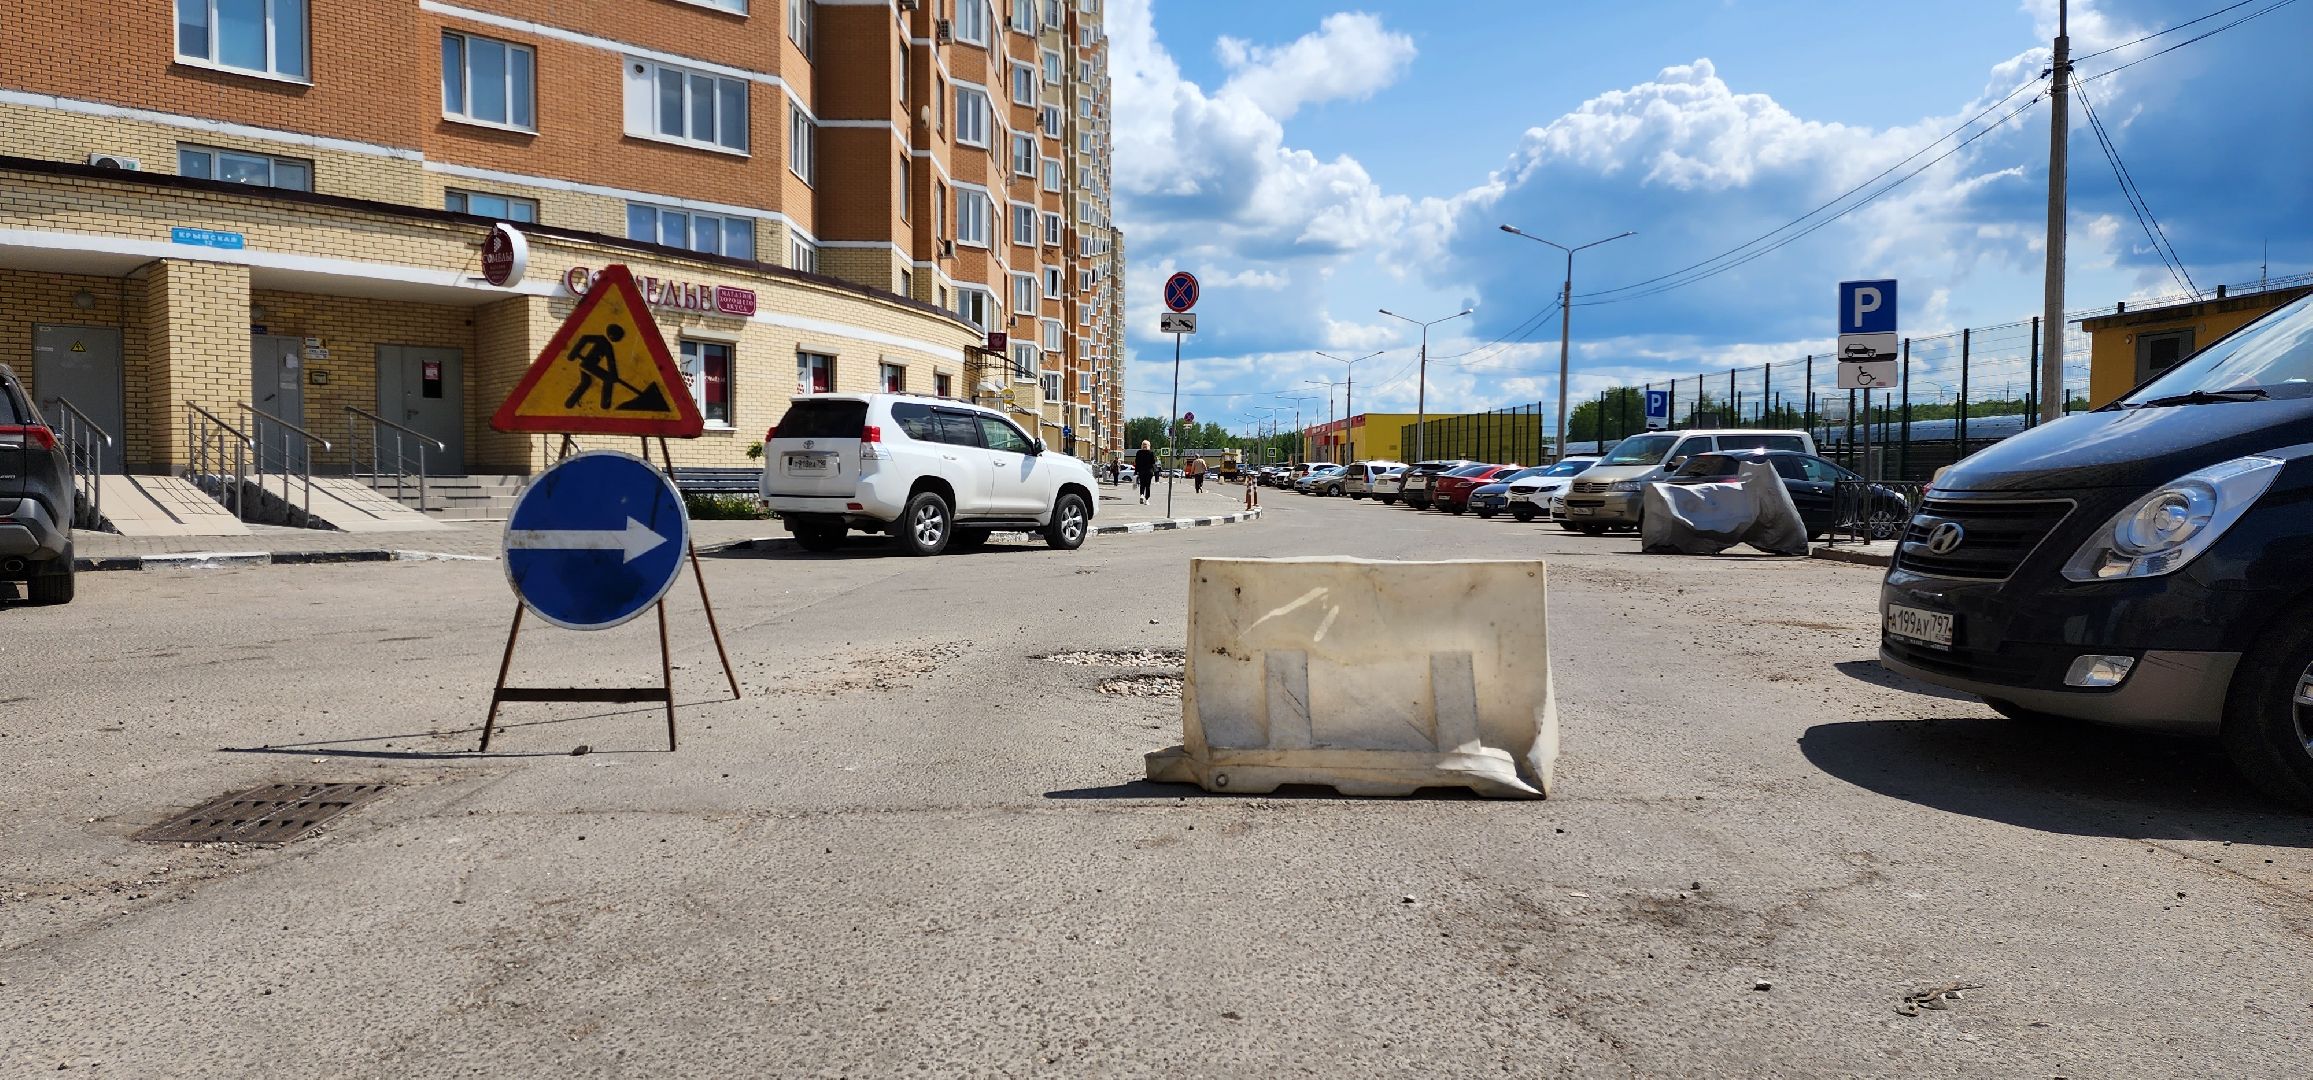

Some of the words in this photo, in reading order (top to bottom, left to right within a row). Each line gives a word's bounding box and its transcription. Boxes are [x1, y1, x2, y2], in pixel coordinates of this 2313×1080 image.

[564, 266, 712, 311] СЕЛЬЕ
[1854, 286, 1882, 327] P
[1651, 393, 1662, 414] P
[1931, 613, 1949, 634] 797
